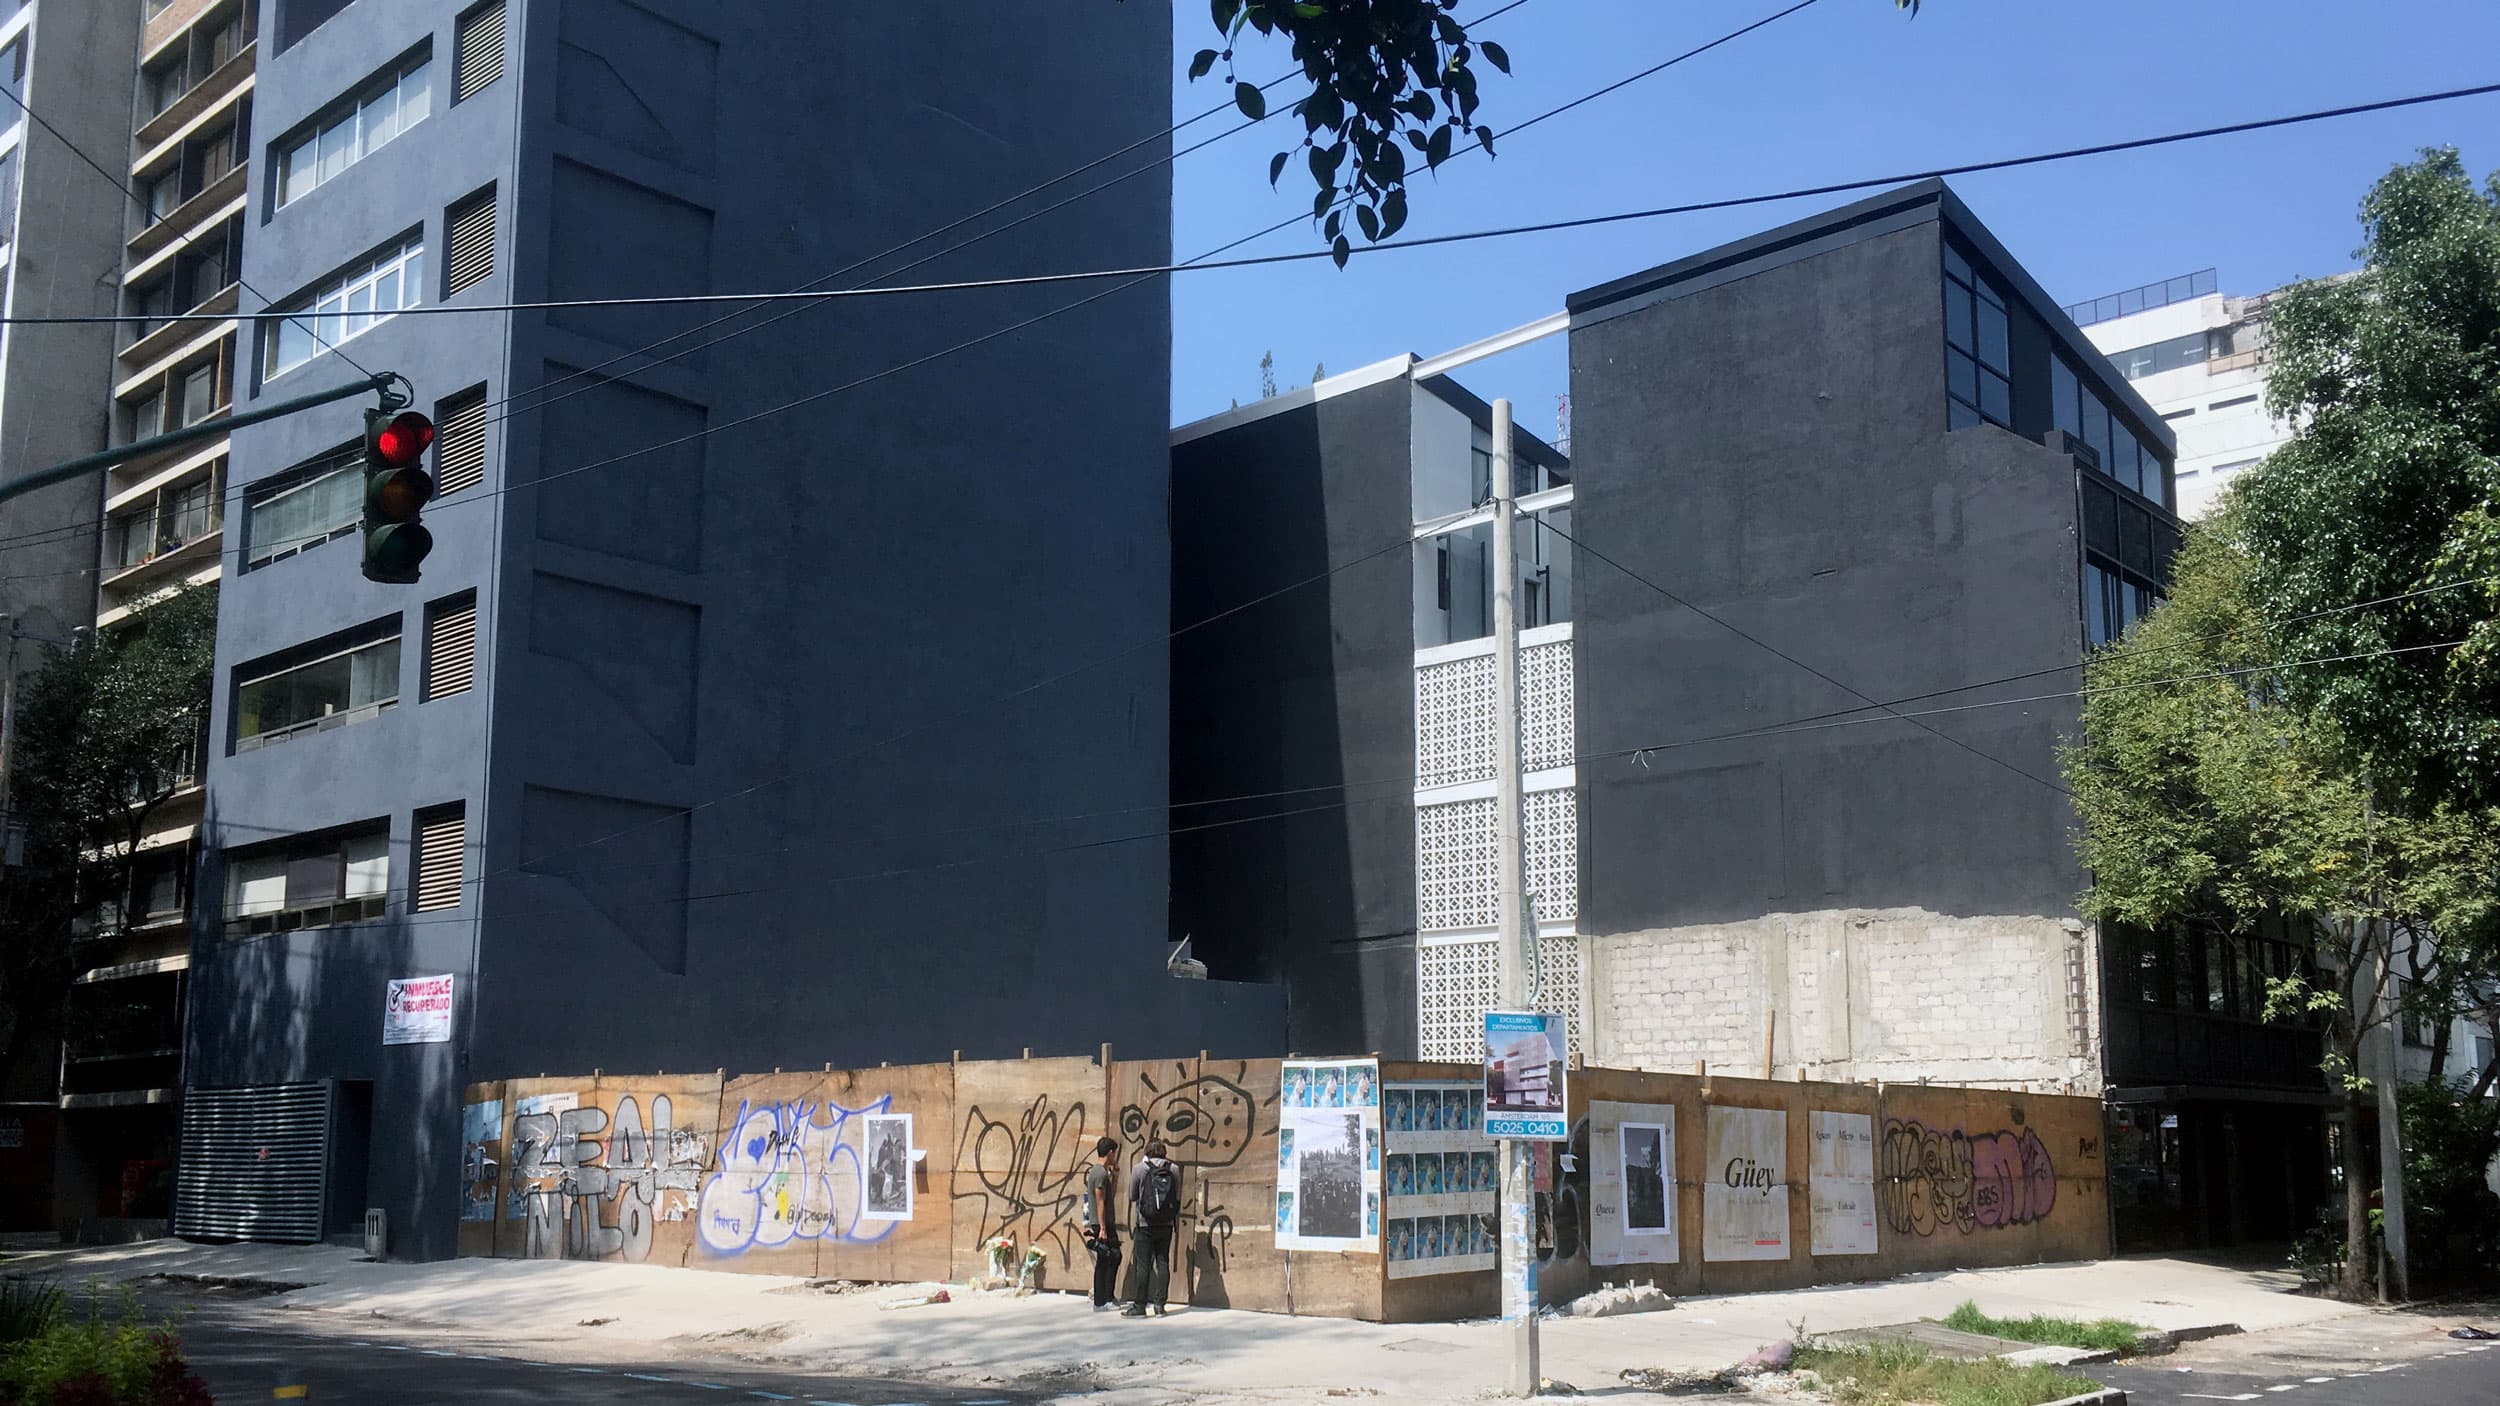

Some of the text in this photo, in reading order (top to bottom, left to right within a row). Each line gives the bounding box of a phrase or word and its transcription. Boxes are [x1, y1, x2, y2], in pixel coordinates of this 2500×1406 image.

[402, 998, 450, 1013] RECUPERADO
[1493, 1121, 1559, 1134] 5025 0410
[1724, 1157, 1775, 1197] Güey
